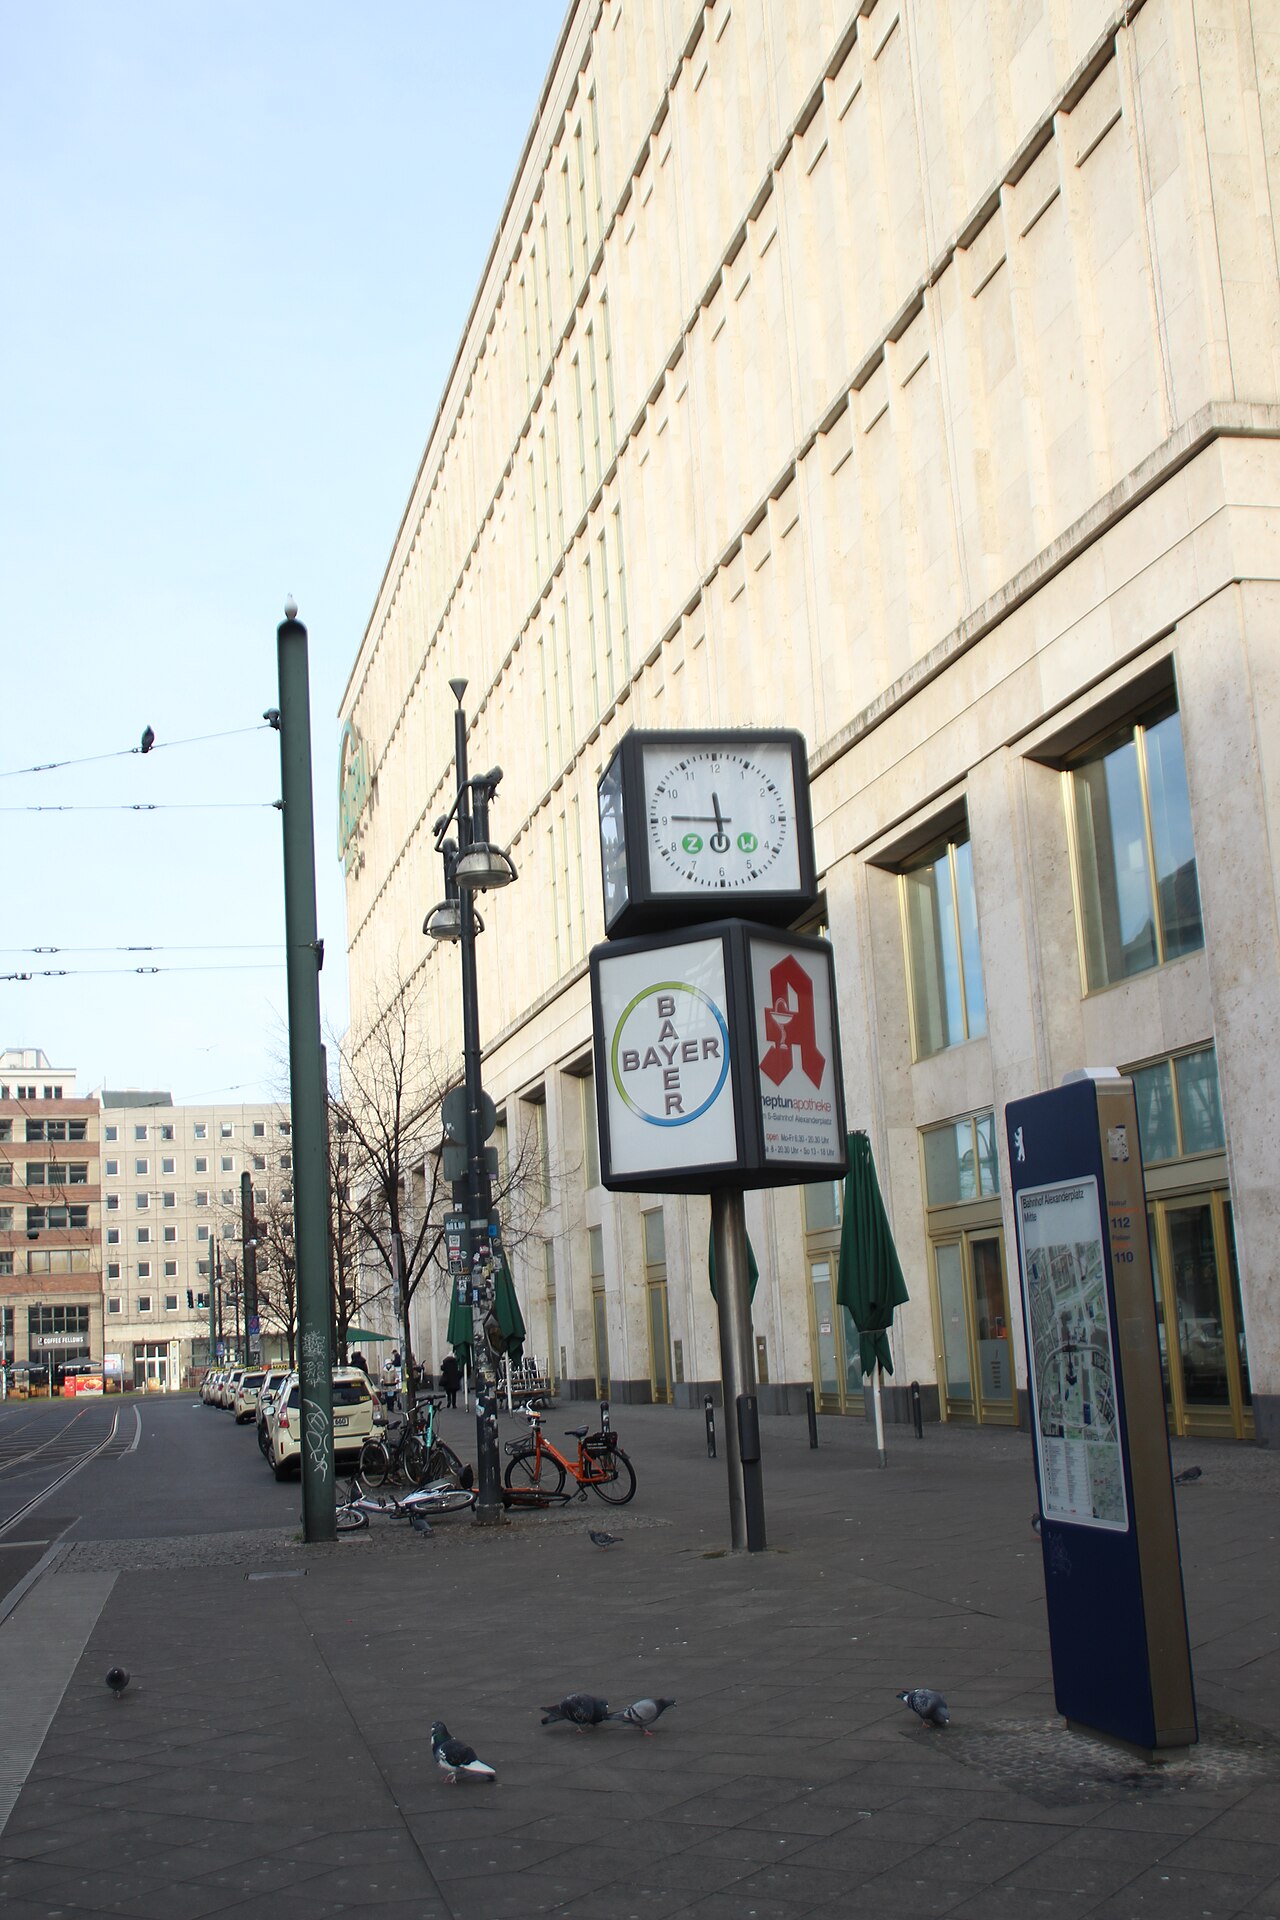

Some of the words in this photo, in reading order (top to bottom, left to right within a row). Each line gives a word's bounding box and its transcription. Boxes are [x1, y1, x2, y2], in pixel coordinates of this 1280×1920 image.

[710, 764, 721, 774] 12
[685, 772, 695, 781] 11
[740, 772, 745, 780] 1
[667, 789, 678, 799] 10
[759, 788, 766, 798] 2
[662, 816, 668, 826] 9
[769, 814, 776, 824] 3
[670, 842, 677, 852] 8
[686, 838, 700, 851] Z
[763, 840, 770, 849] 4
[691, 860, 698, 870] 7
[746, 859, 752, 869] 5
[719, 867, 725, 877] 6
[622, 1037, 721, 1072] BAYER
[760, 1094, 832, 1113] neptunapotheke
[795, 1114, 832, 1125] Alexanderplatz
[1022, 1195, 1044, 1209] Bahnhof
[1044, 1189, 1084, 1205] Alexanderplatz
[1023, 1212, 1038, 1223] Mitte
[1111, 1216, 1131, 1229] 112
[1114, 1251, 1134, 1264] 110
[43, 1337, 62, 1345] COFFEE
[62, 1336, 84, 1344] FELLOWS
